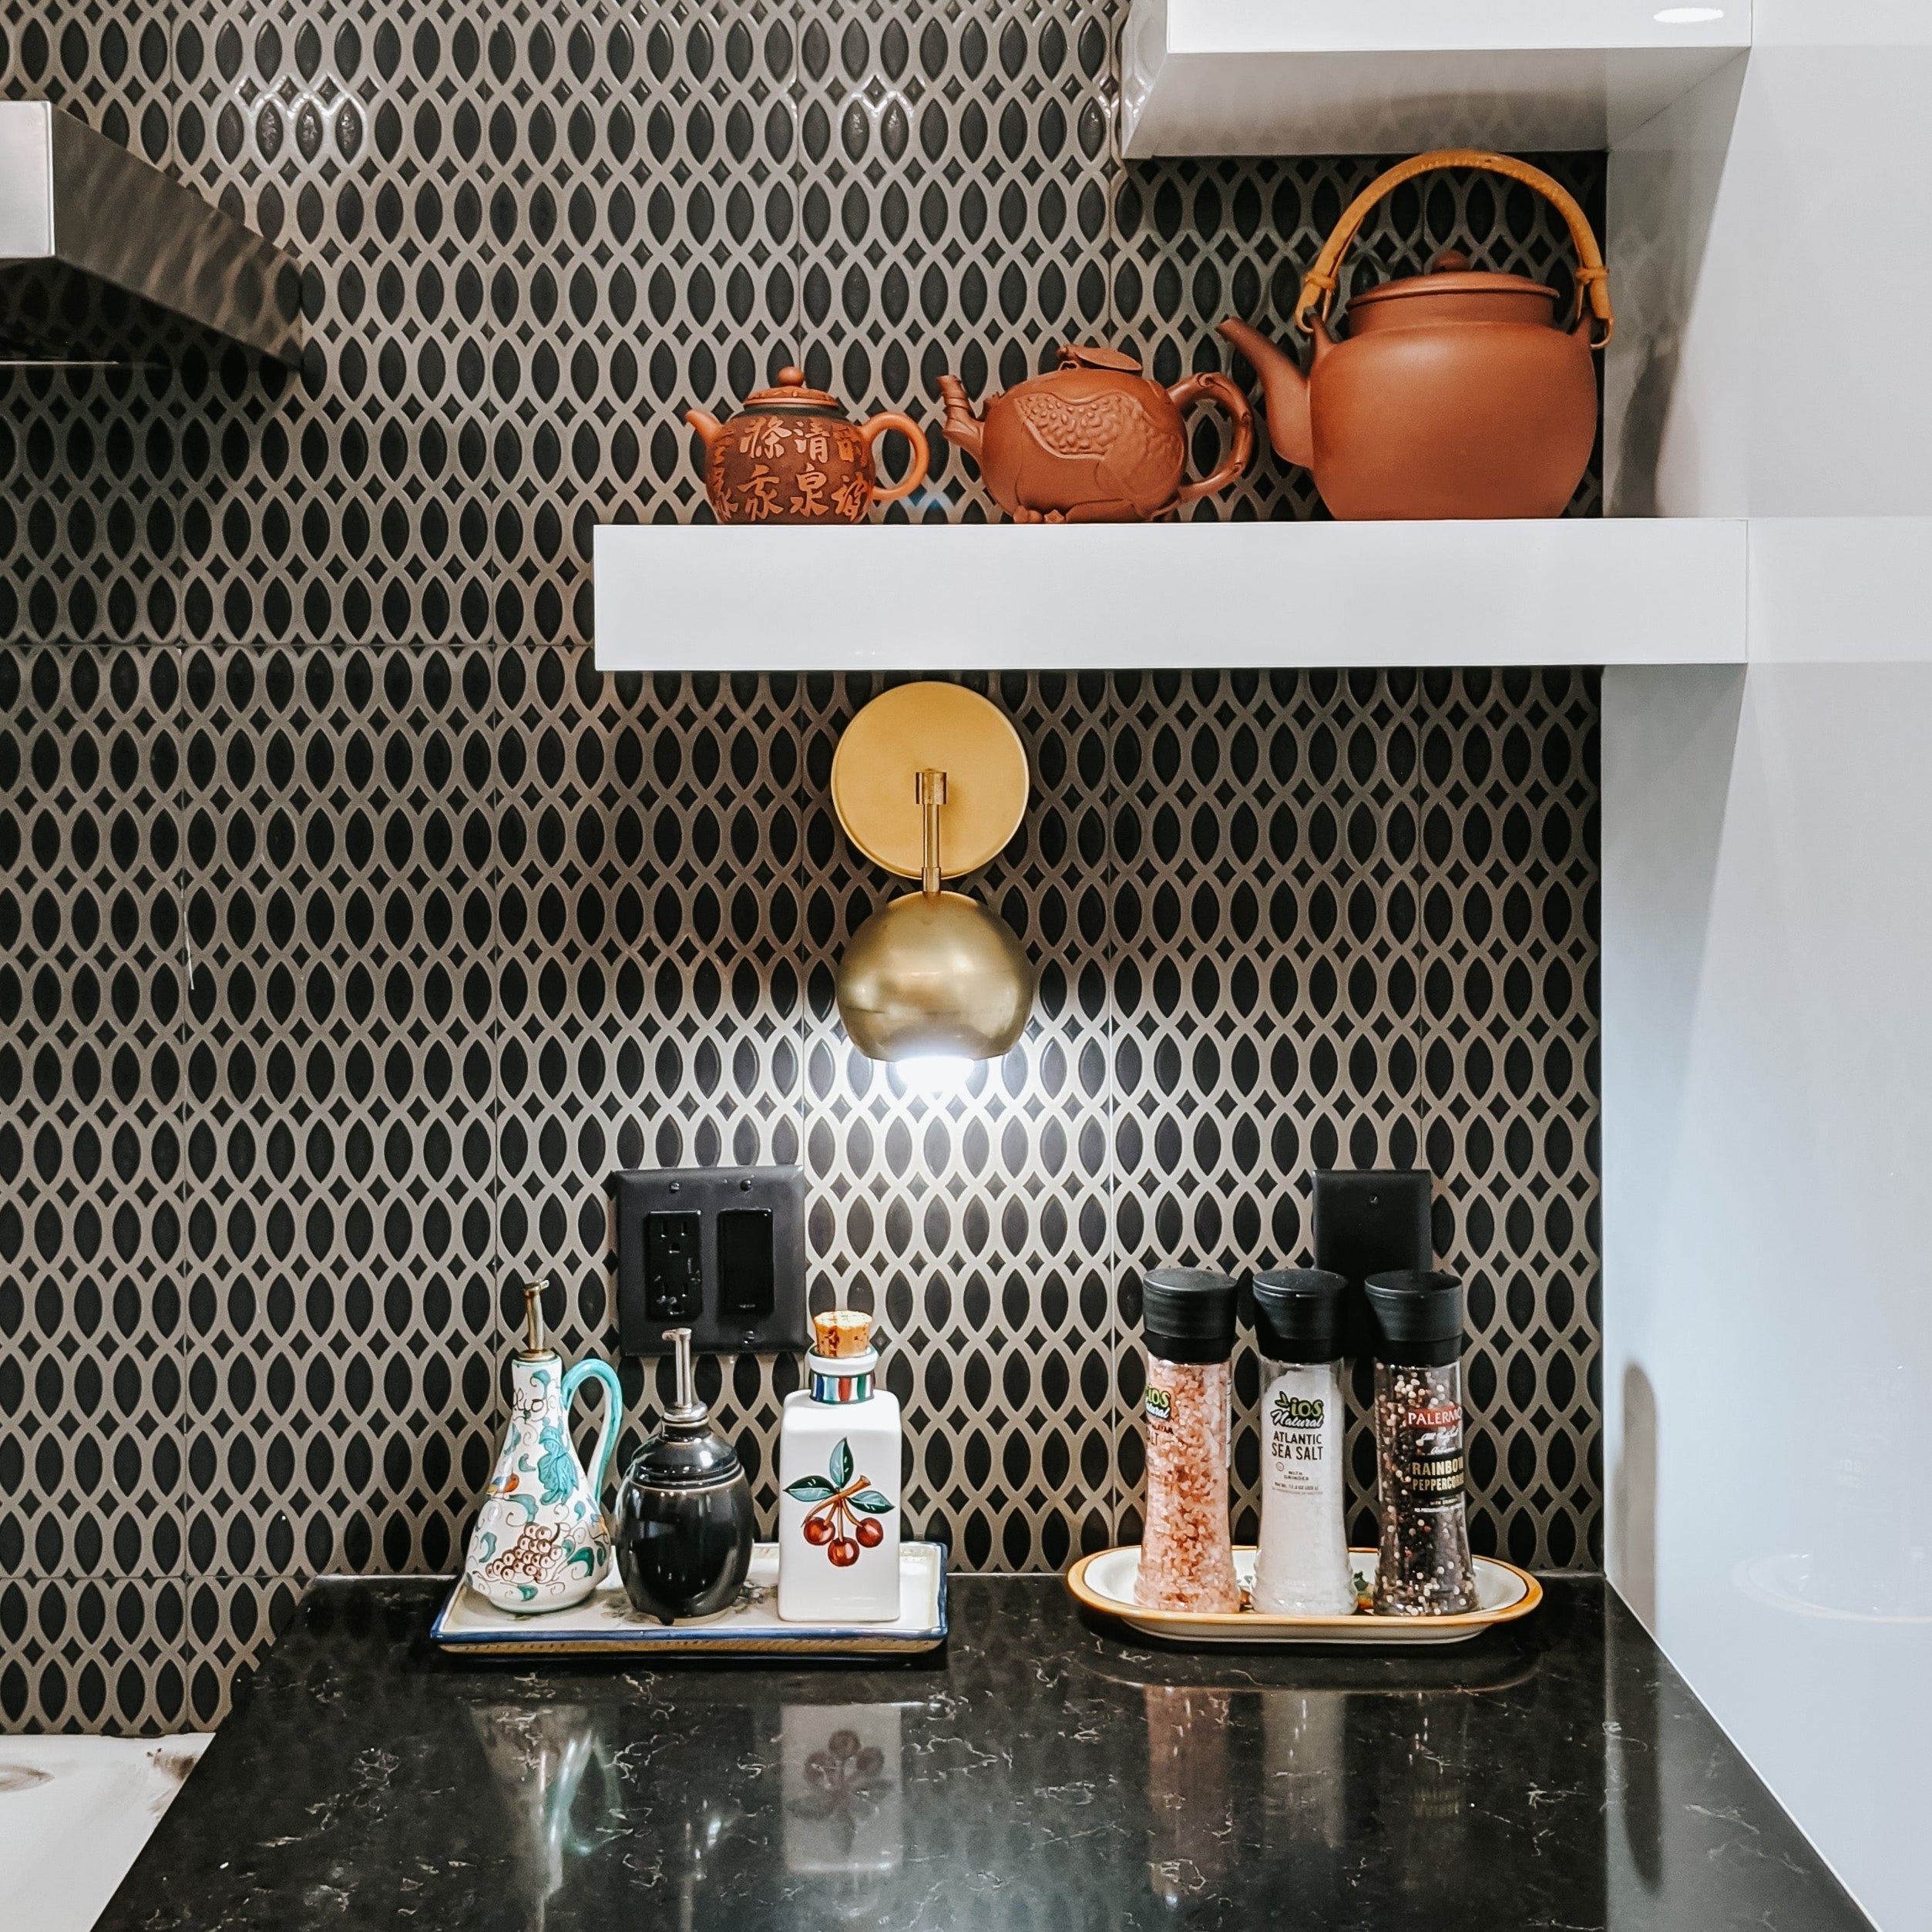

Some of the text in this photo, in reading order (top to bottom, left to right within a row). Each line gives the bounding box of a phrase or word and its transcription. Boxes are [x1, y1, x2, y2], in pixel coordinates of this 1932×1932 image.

[1145, 1396, 1171, 1420] tural
[1289, 1397, 1324, 1417] ios
[1408, 1406, 1462, 1425] PALERMO
[1270, 1409, 1324, 1429] Natural
[1273, 1430, 1322, 1445] ATLANTIC
[1272, 1443, 1323, 1460] SEA SALT
